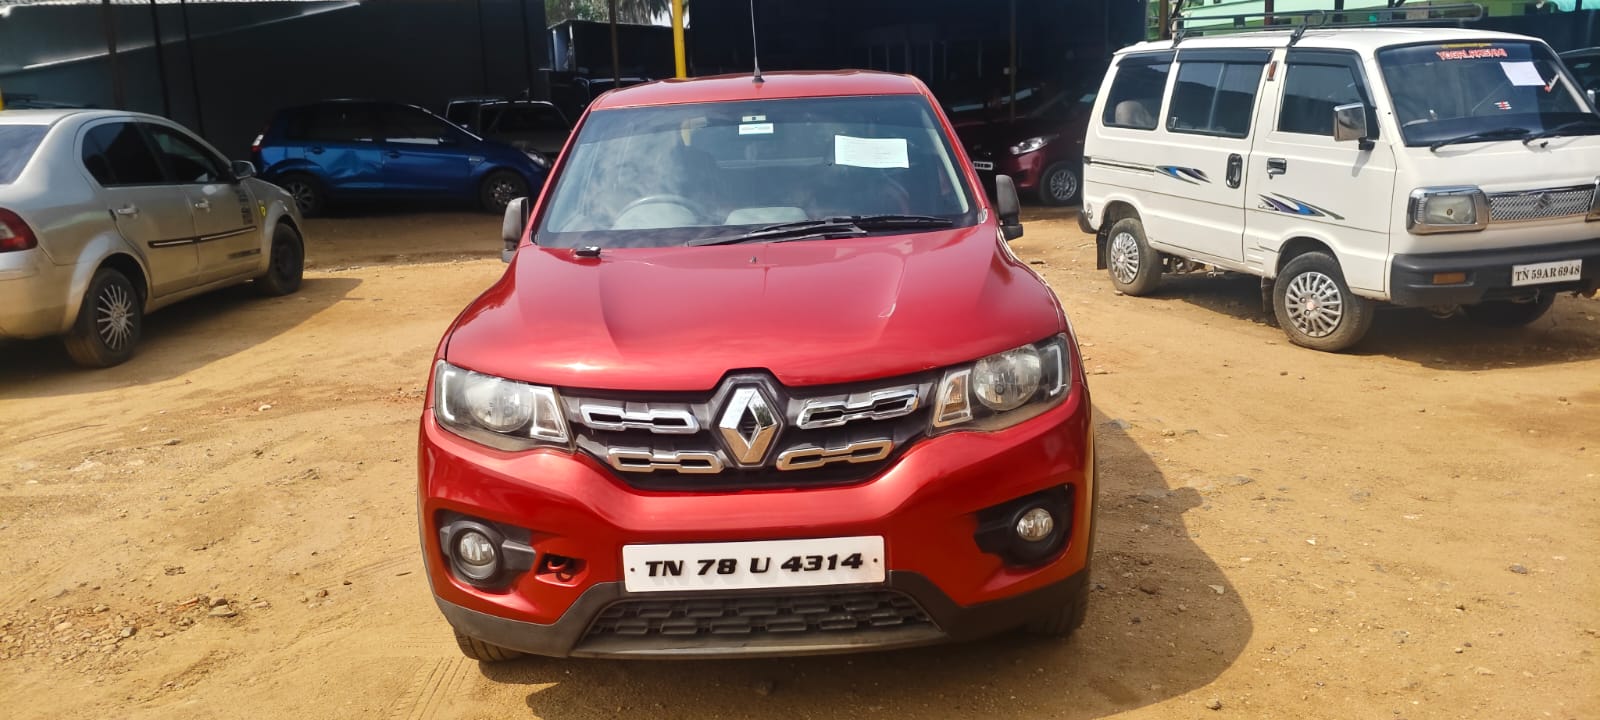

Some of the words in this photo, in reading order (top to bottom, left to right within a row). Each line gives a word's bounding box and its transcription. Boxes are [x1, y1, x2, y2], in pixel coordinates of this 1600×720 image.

[1515, 269, 1530, 281] TN
[645, 560, 684, 577] TN
[697, 558, 738, 576] 78
[749, 557, 771, 574] U
[780, 552, 864, 572] 4314
